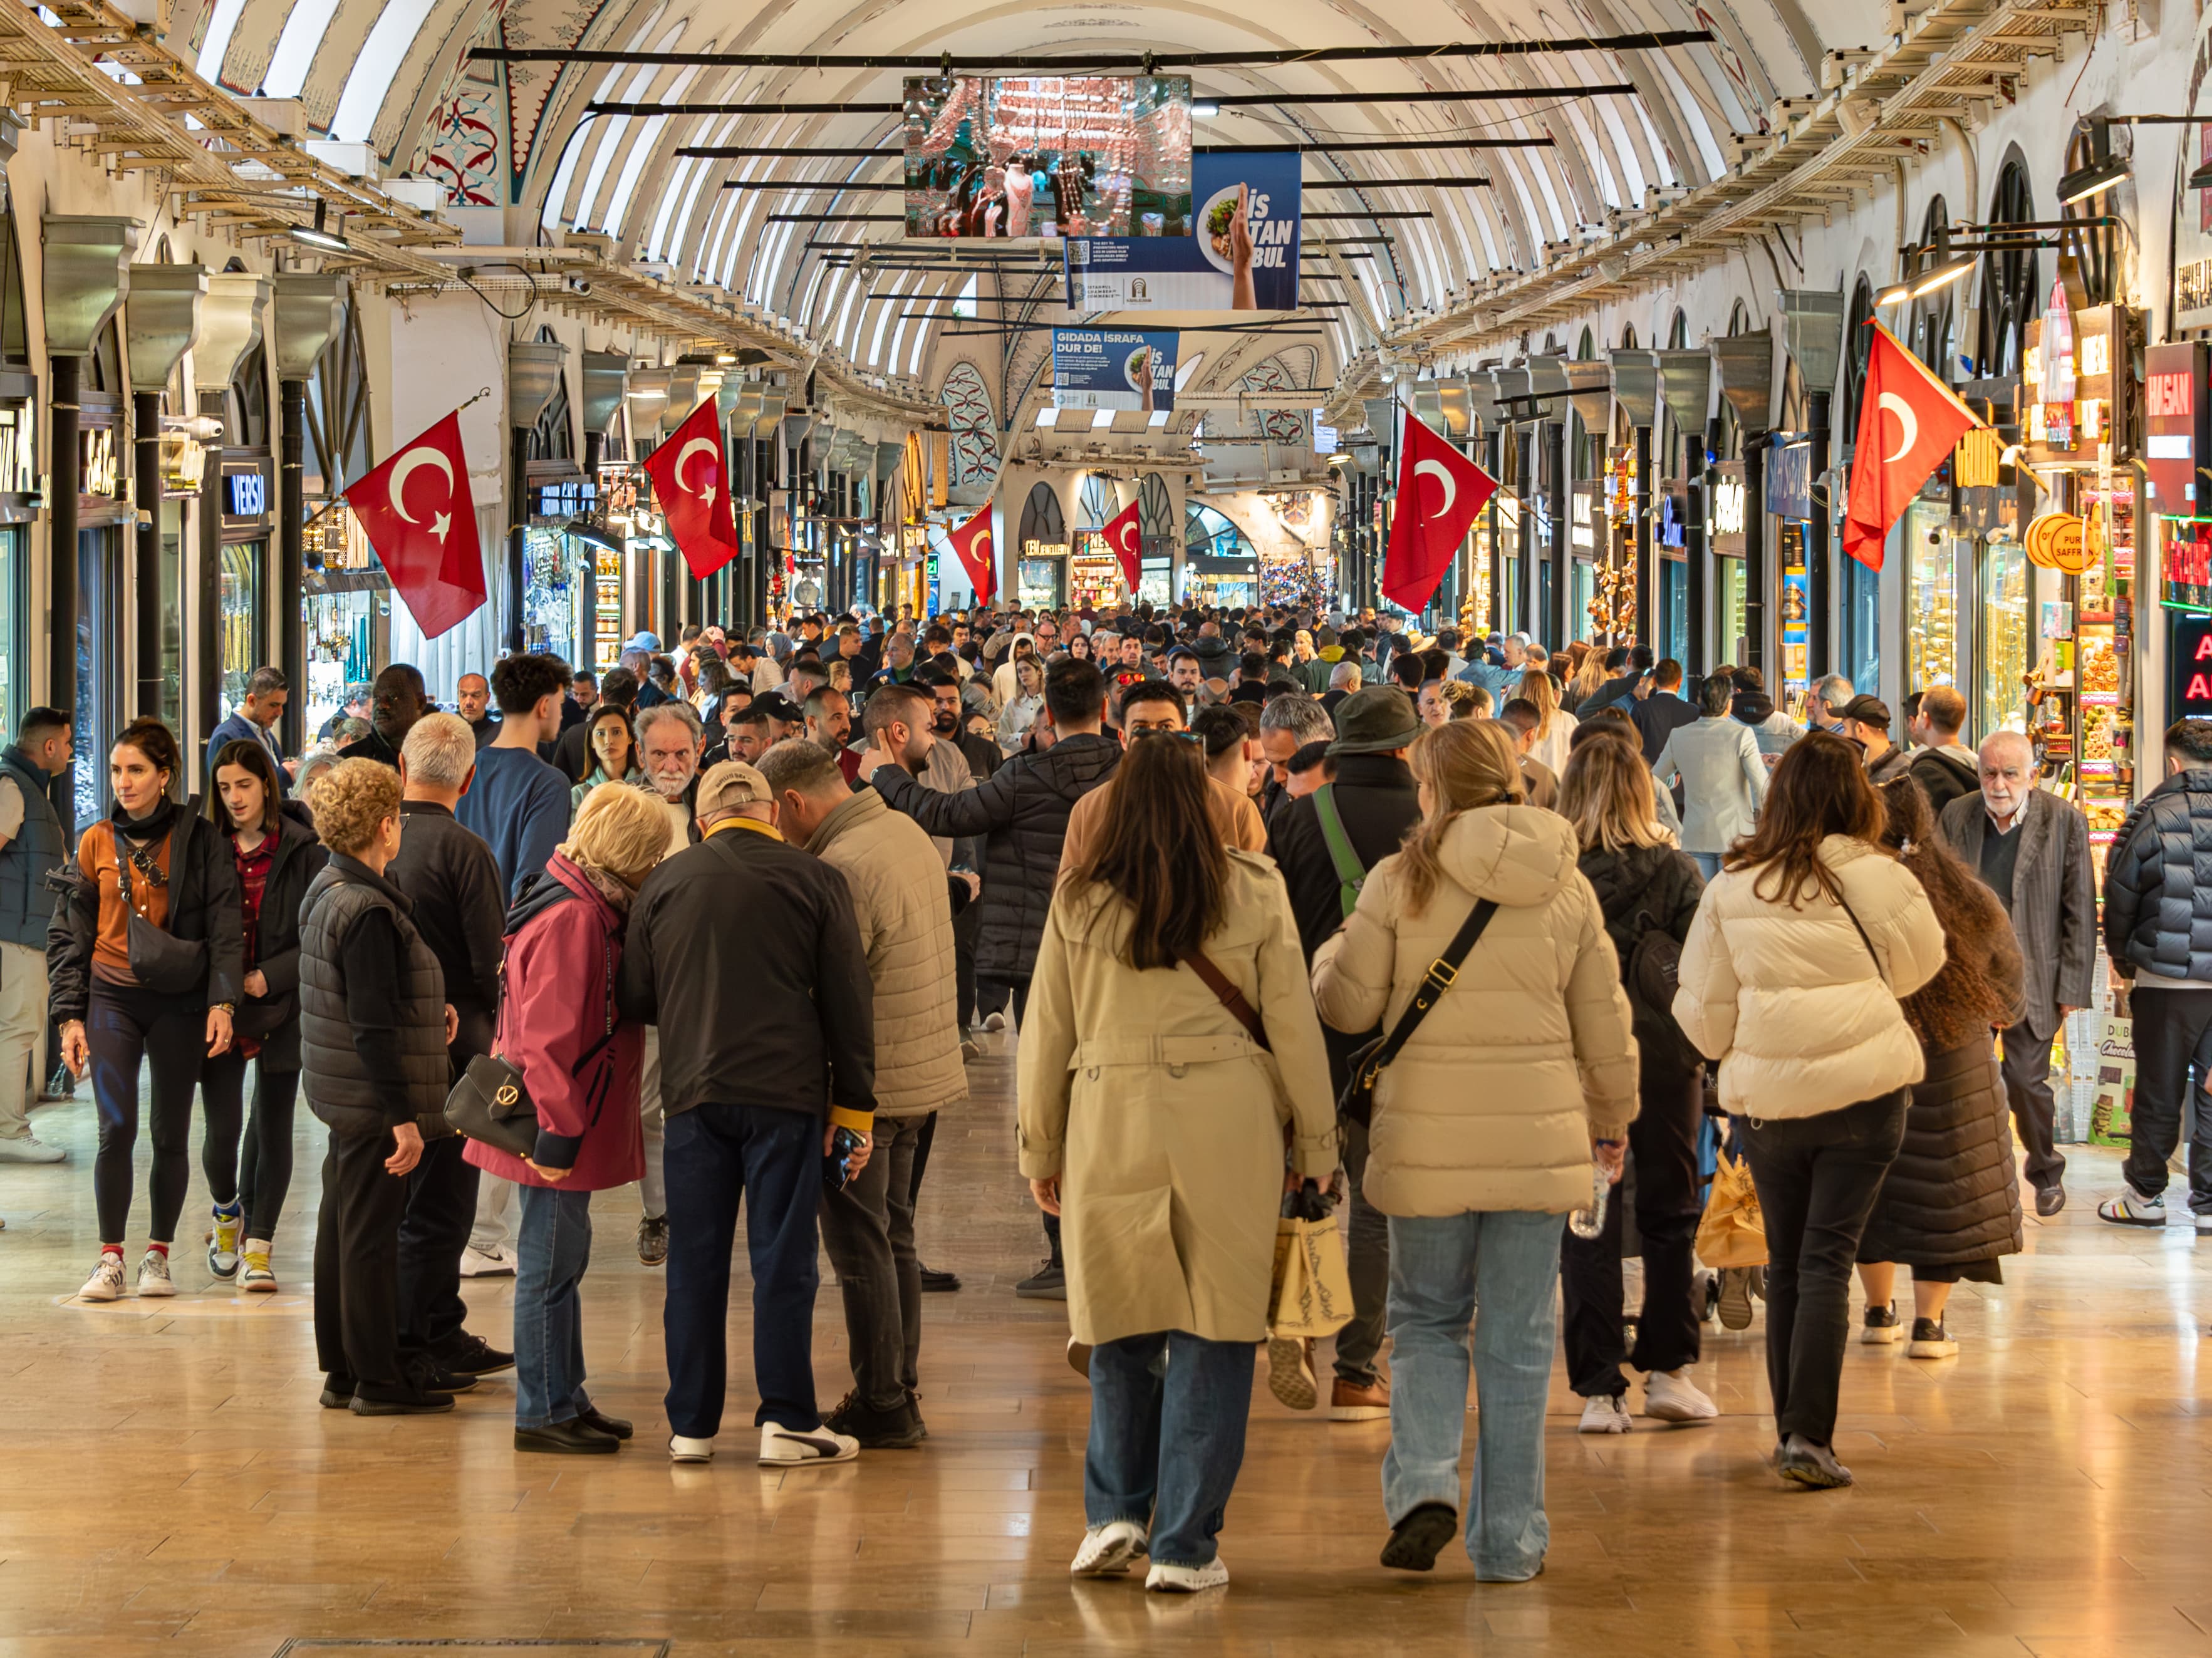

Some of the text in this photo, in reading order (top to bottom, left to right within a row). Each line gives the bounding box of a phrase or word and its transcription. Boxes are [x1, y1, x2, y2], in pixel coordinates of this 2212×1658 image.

[1249, 220, 1294, 245] TAN
[1251, 247, 1286, 268] BUL
[1057, 331, 1144, 343] GIDADA İSRAFA
[1057, 344, 1103, 353] DUR DE!
[1153, 365, 1175, 378] TAN
[1153, 379, 1170, 390] BUL
[2147, 372, 2189, 417] HASAN
[2064, 536, 2084, 544] PUR
[2056, 548, 2094, 557] SAFFRN
